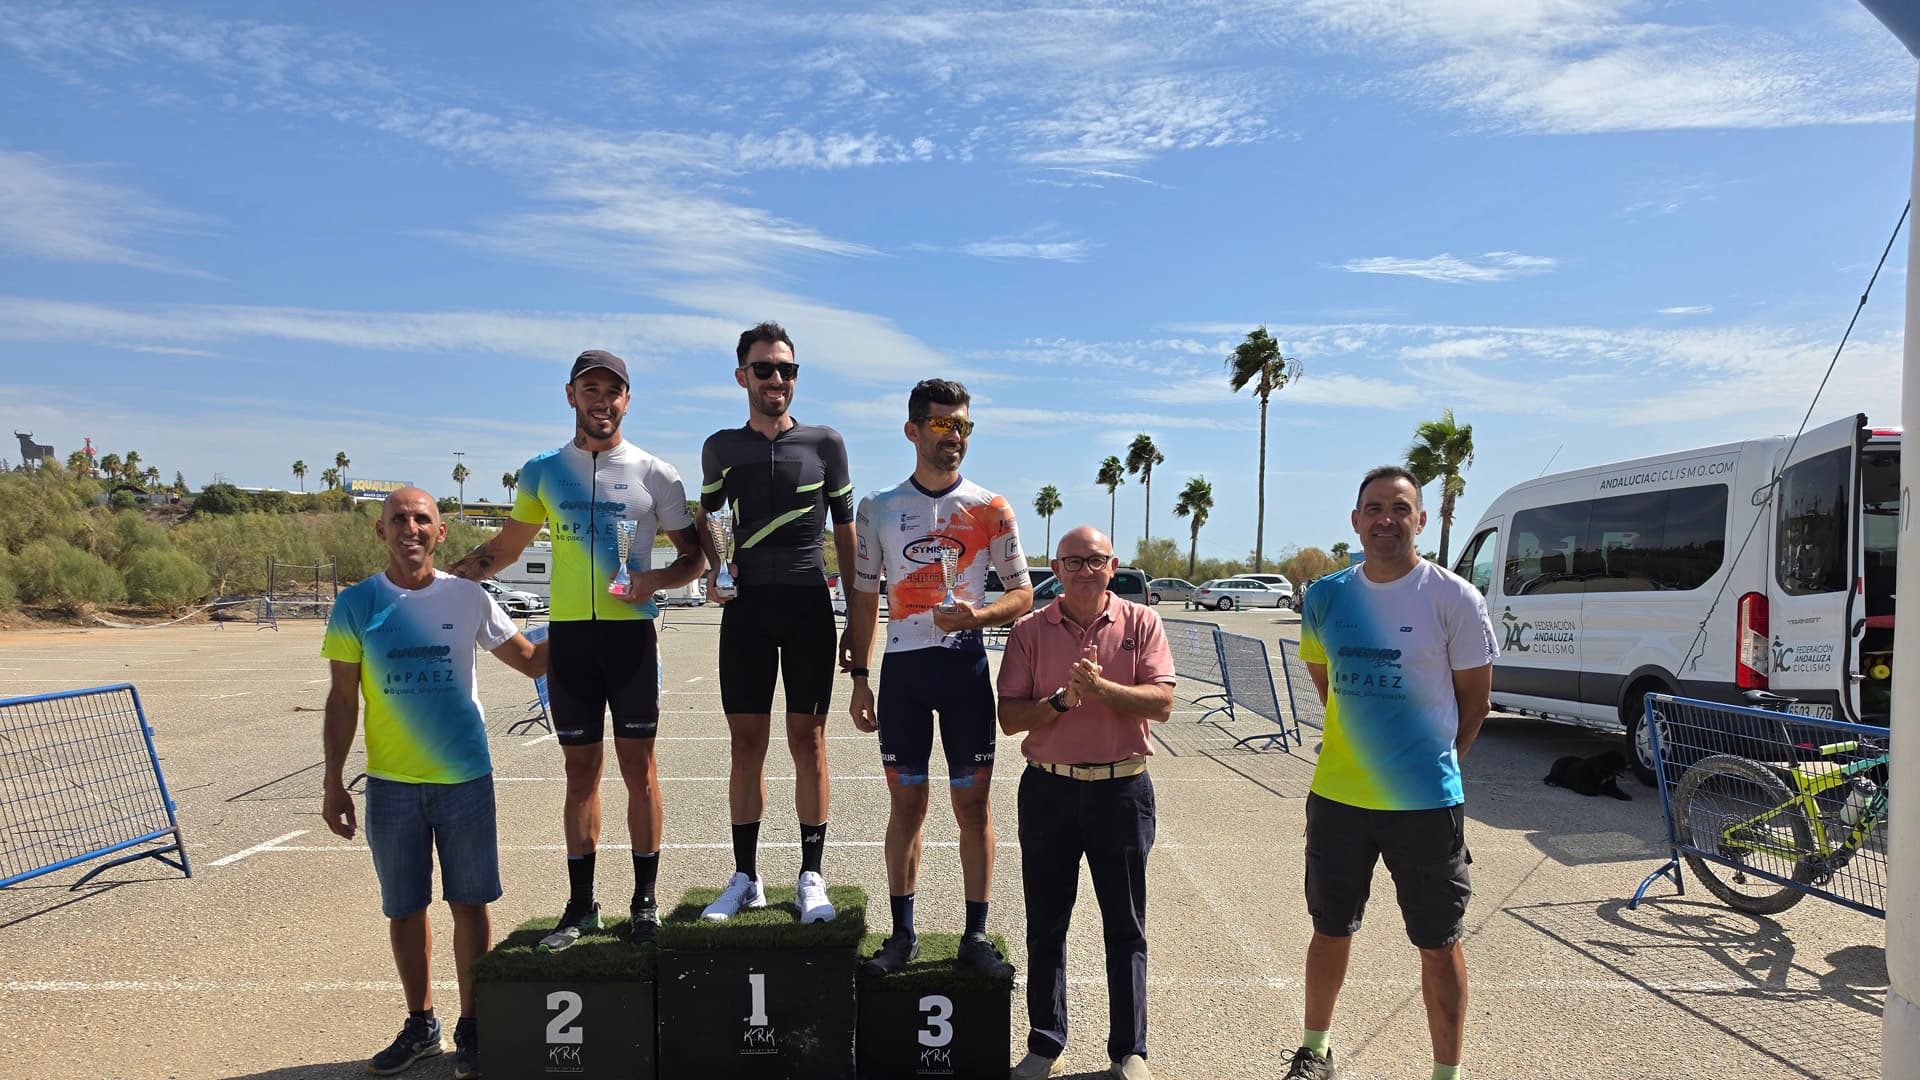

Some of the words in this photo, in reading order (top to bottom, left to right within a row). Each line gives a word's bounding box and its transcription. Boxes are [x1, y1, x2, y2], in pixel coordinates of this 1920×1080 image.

[1599, 460, 1736, 491] ANDALUCIACICLISMO.COM
[1533, 632, 1574, 642] ANDALUZA
[1532, 643, 1575, 655] CICLISMO
[1793, 654, 1831, 663] ANDALUZA
[1792, 663, 1831, 673] CICLISMO
[749, 973, 768, 1026] 1
[546, 990, 583, 1044] 2
[918, 994, 954, 1048] 3
[743, 1027, 775, 1047] KRK
[549, 1046, 581, 1065] KRK
[920, 1048, 951, 1068] KRK
